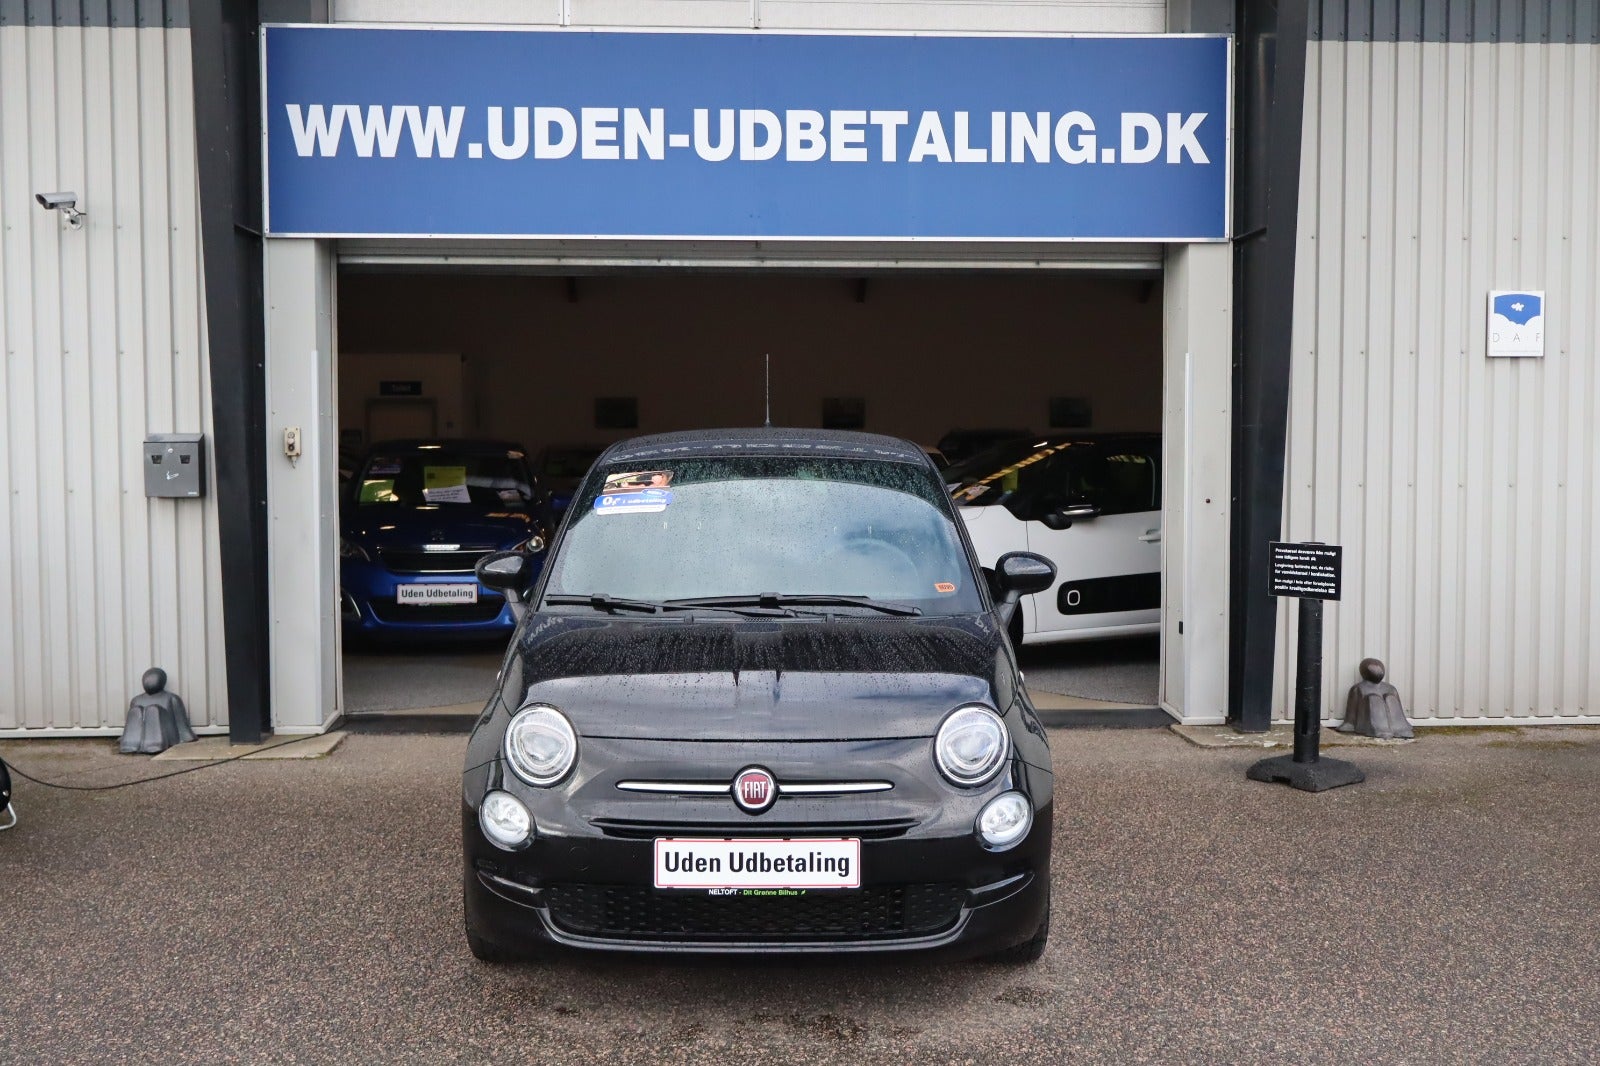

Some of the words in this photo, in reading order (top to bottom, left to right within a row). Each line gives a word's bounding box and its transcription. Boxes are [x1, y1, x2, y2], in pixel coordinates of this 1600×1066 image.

[285, 103, 1211, 165] WWW.UDEN-UDBETALING.DK
[401, 589, 424, 598] Uden
[426, 588, 473, 599] Udbetaling
[744, 781, 767, 798] FIAT
[664, 851, 721, 873] Uden
[729, 851, 850, 878] Udbetaling
